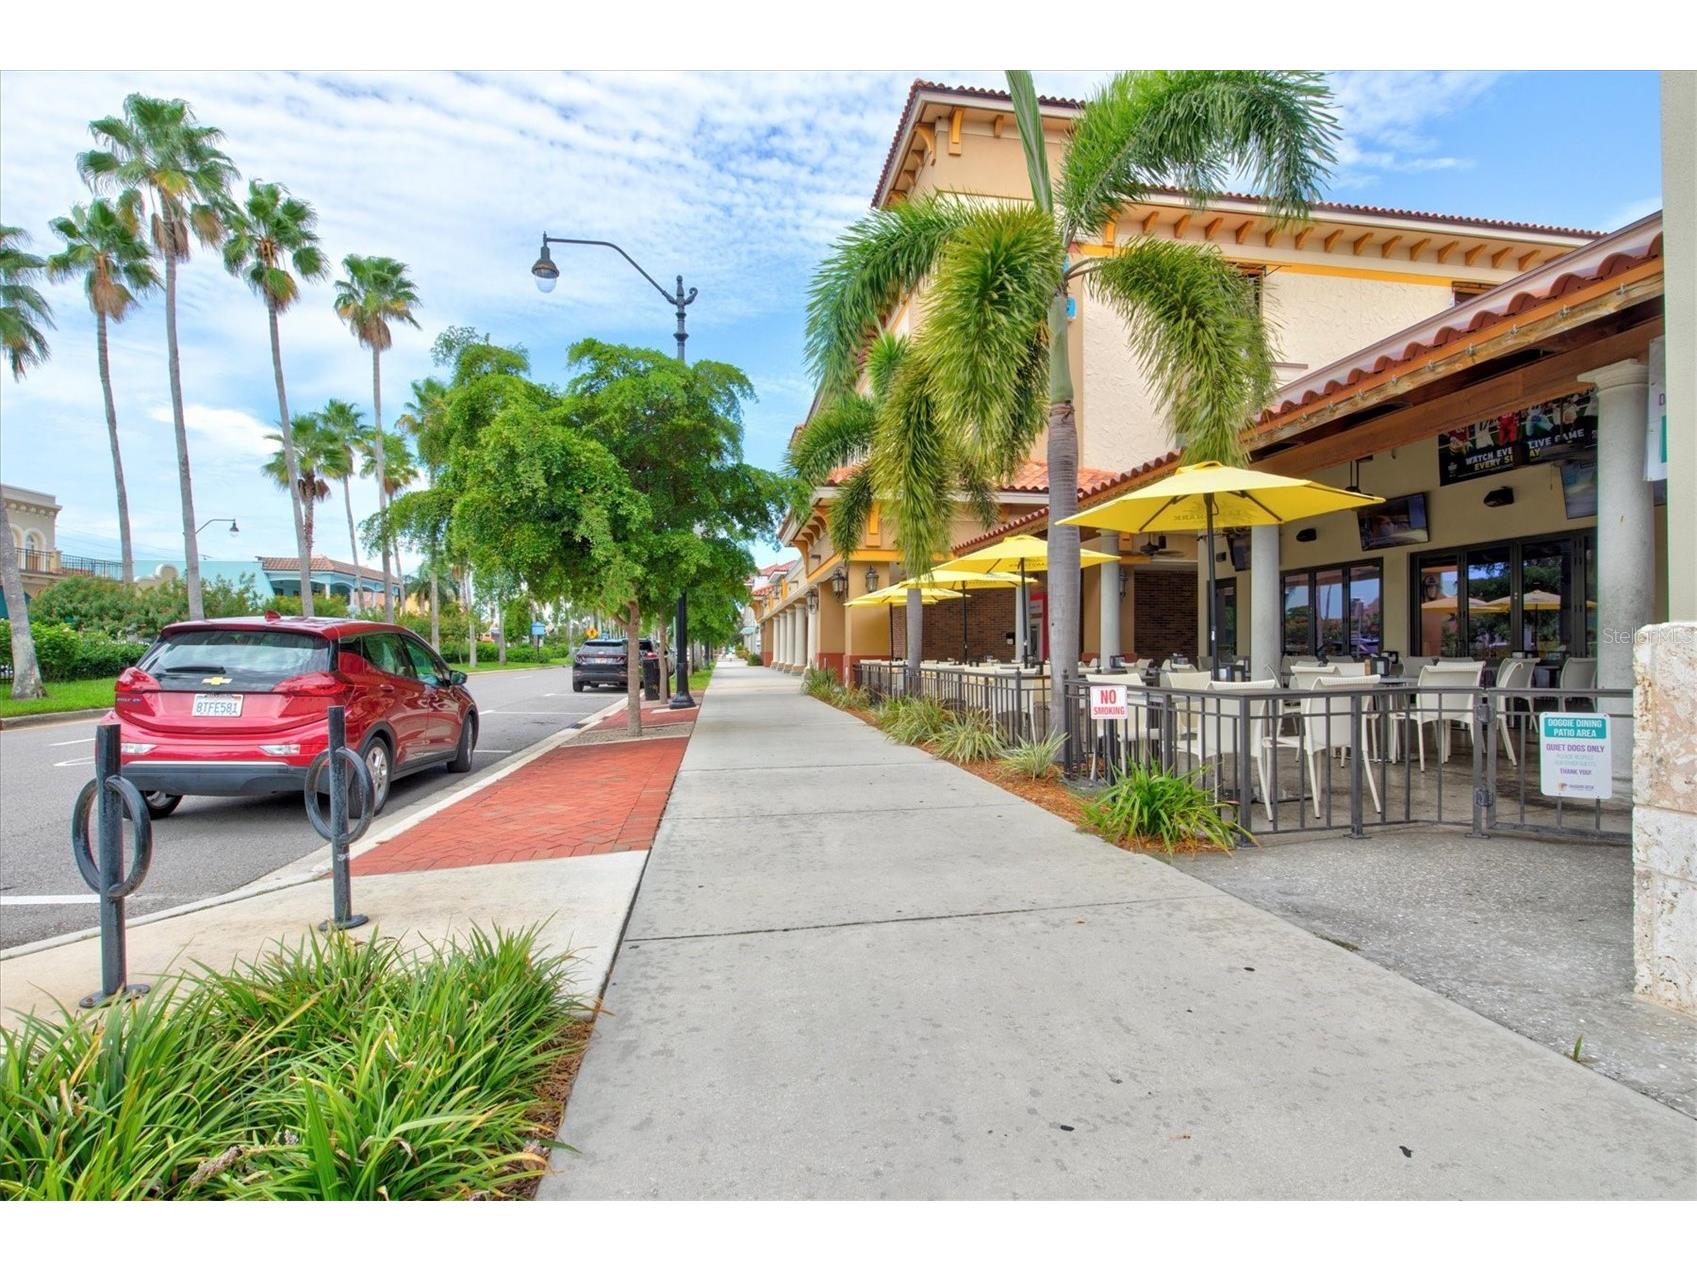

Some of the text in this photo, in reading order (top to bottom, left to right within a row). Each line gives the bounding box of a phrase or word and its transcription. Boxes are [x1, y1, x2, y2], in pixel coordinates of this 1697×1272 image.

[1466, 451, 1493, 465] WATCH
[1528, 436, 1552, 449] LIVE
[1474, 458, 1501, 471] EVERY
[1100, 689, 1116, 704] NO
[1094, 706, 1125, 715] SMOKING
[1548, 719, 1602, 728] DOGGIE DINING
[1553, 728, 1597, 737] PATIO AREA
[1546, 744, 1605, 753] QUIET DOGS ONLY
[1560, 767, 1578, 775] THANK
